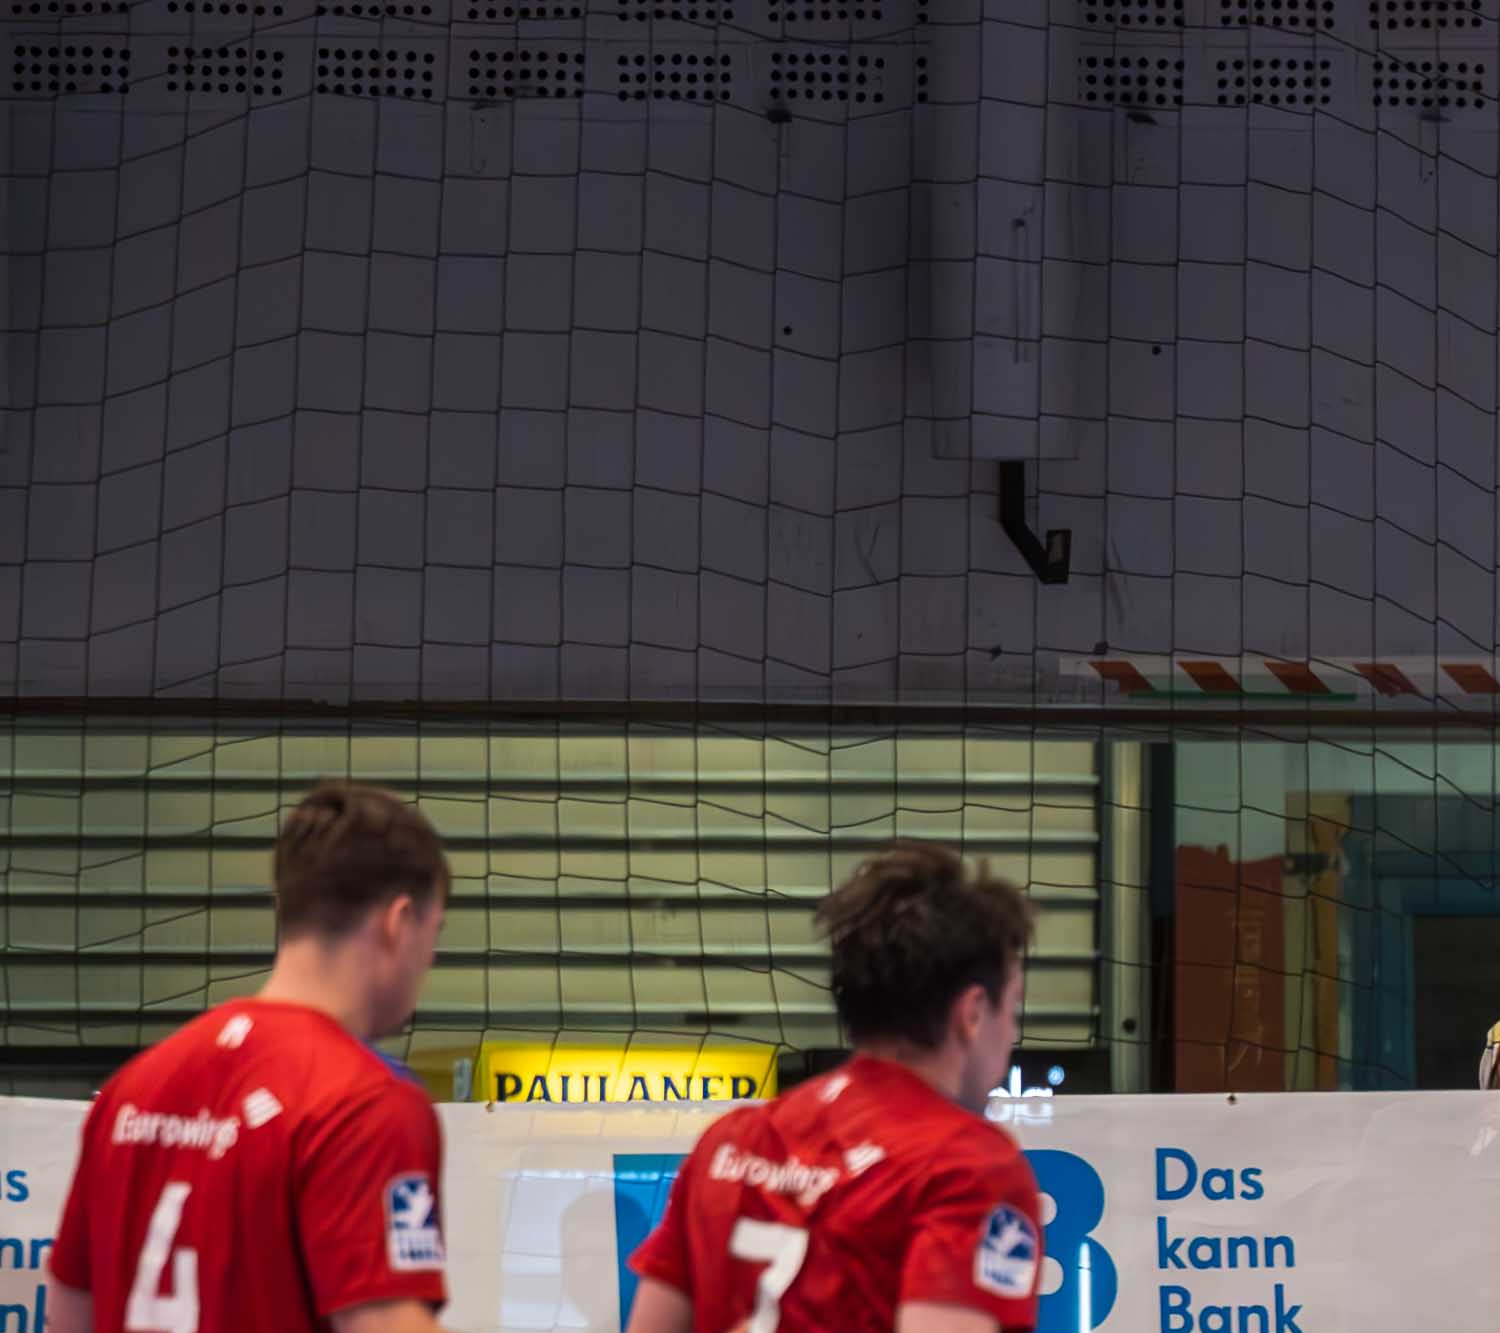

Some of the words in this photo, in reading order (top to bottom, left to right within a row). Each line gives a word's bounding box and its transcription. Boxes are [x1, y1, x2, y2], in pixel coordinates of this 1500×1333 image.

[496, 1073, 757, 1101] PAULANER
[1155, 1147, 1264, 1202] Das
[1156, 1215, 1297, 1270] kann
